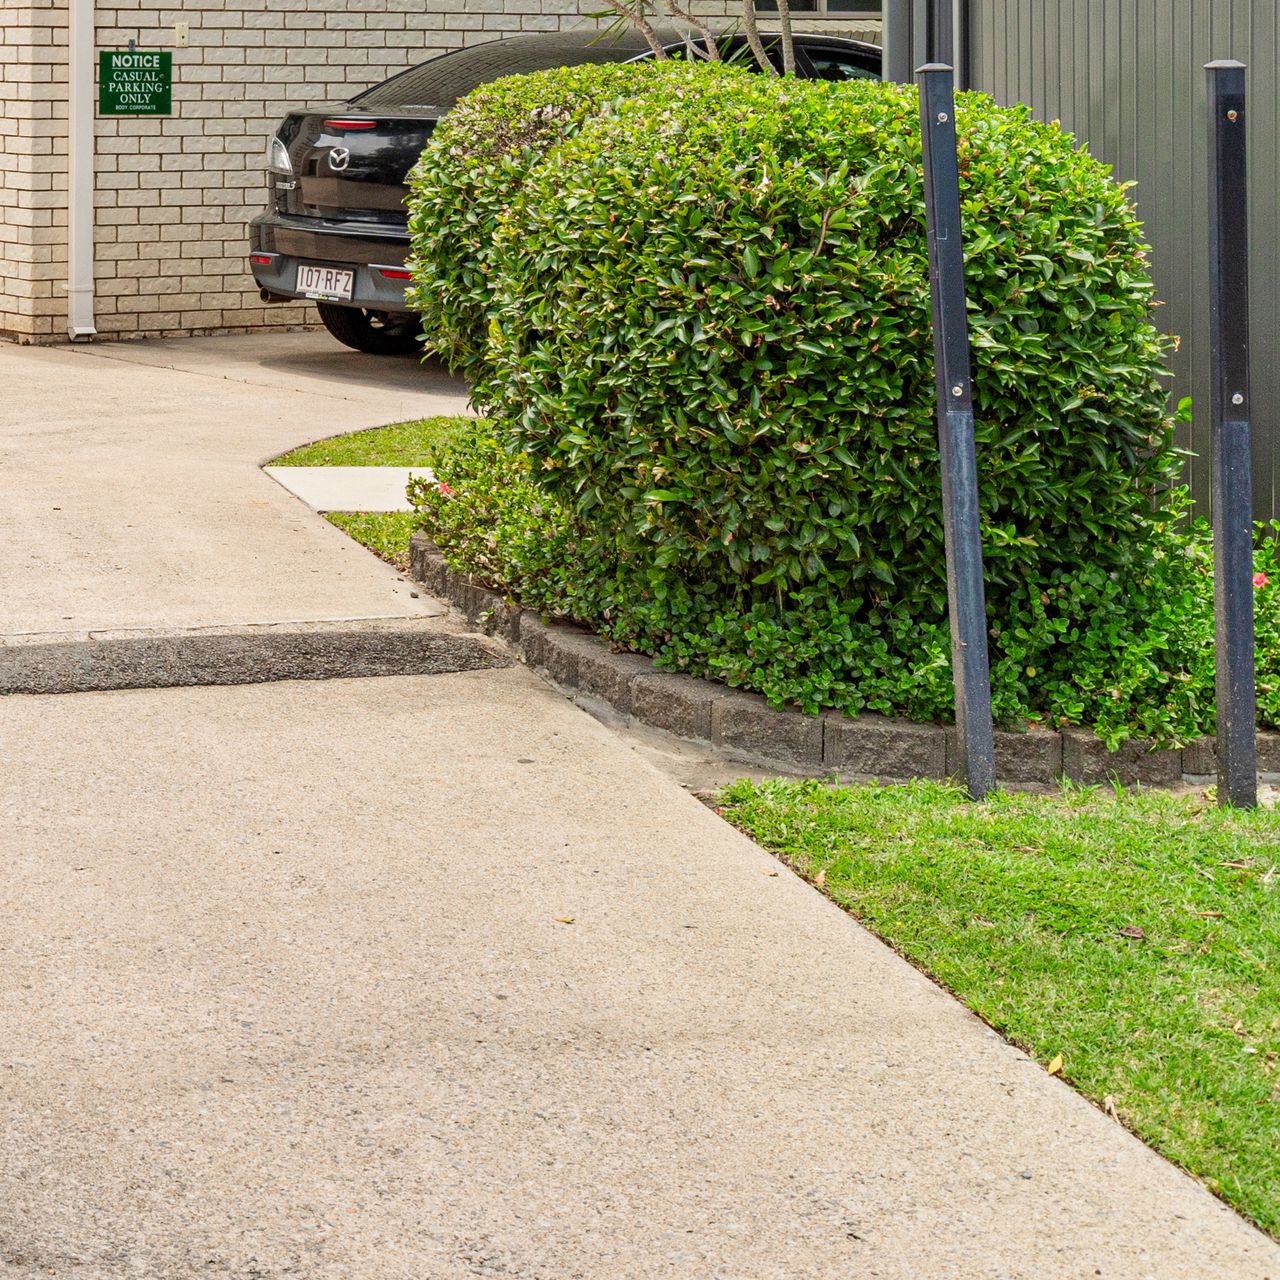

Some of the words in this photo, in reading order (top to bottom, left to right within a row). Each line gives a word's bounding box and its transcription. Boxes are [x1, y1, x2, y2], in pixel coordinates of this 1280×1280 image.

[112, 55, 160, 68] NOTICE
[113, 71, 159, 81] CASUAL
[109, 82, 163, 93] PARKING
[120, 93, 151, 104] ONLY
